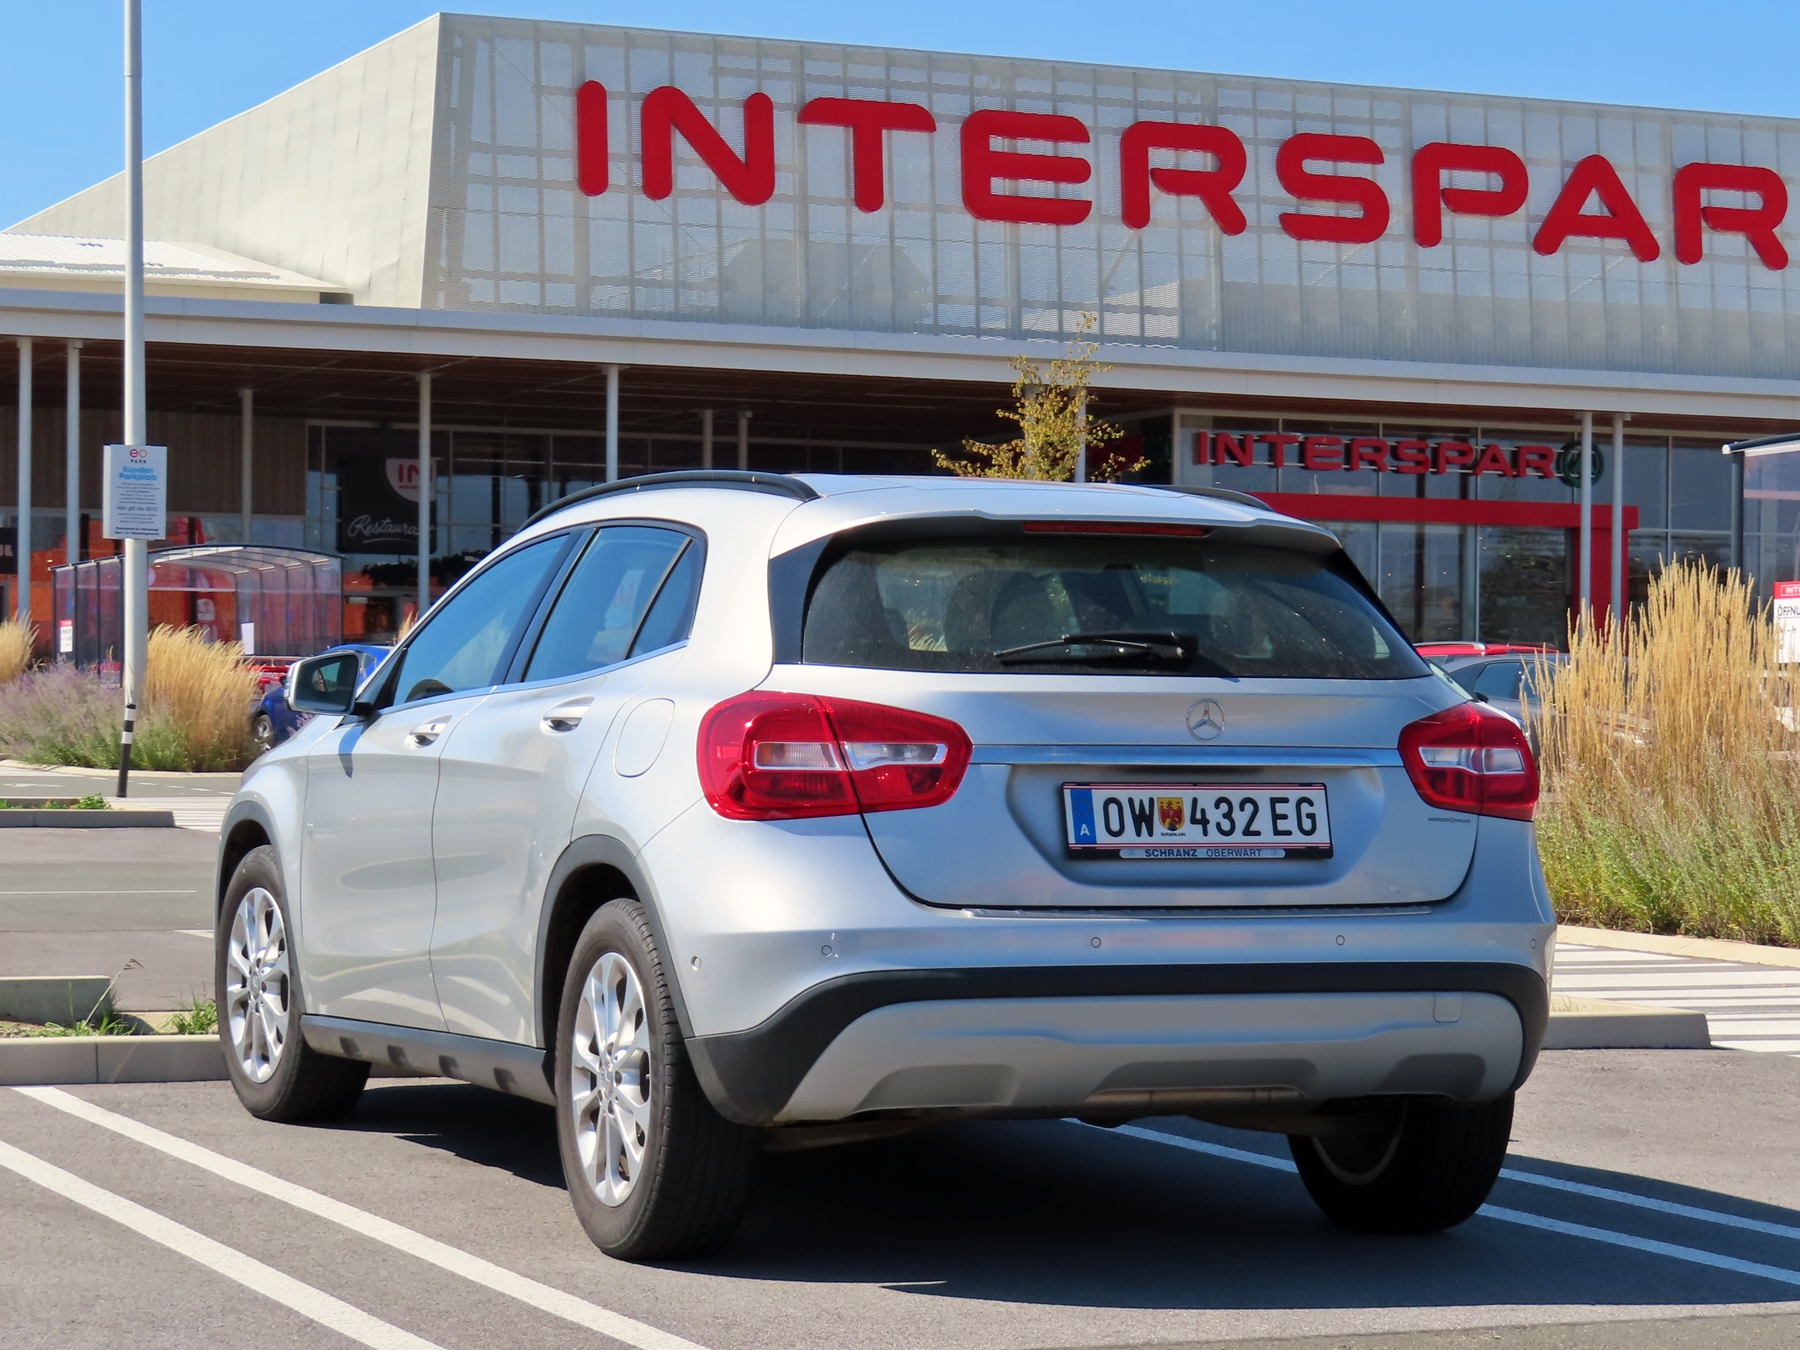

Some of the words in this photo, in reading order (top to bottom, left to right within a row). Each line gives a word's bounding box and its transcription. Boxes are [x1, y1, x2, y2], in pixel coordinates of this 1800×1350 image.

[576, 80, 1788, 271] INTERSPAR
[1197, 431, 1555, 478] INTERSPAR
[119, 473, 157, 481] Parkplatz
[347, 515, 436, 537] Restaura
[1785, 586, 1800, 594] INT
[1103, 797, 1155, 837] OW
[1080, 823, 1090, 836] A
[1144, 848, 1198, 858] SCHRANZ
[1206, 848, 1262, 858] OBERWART
